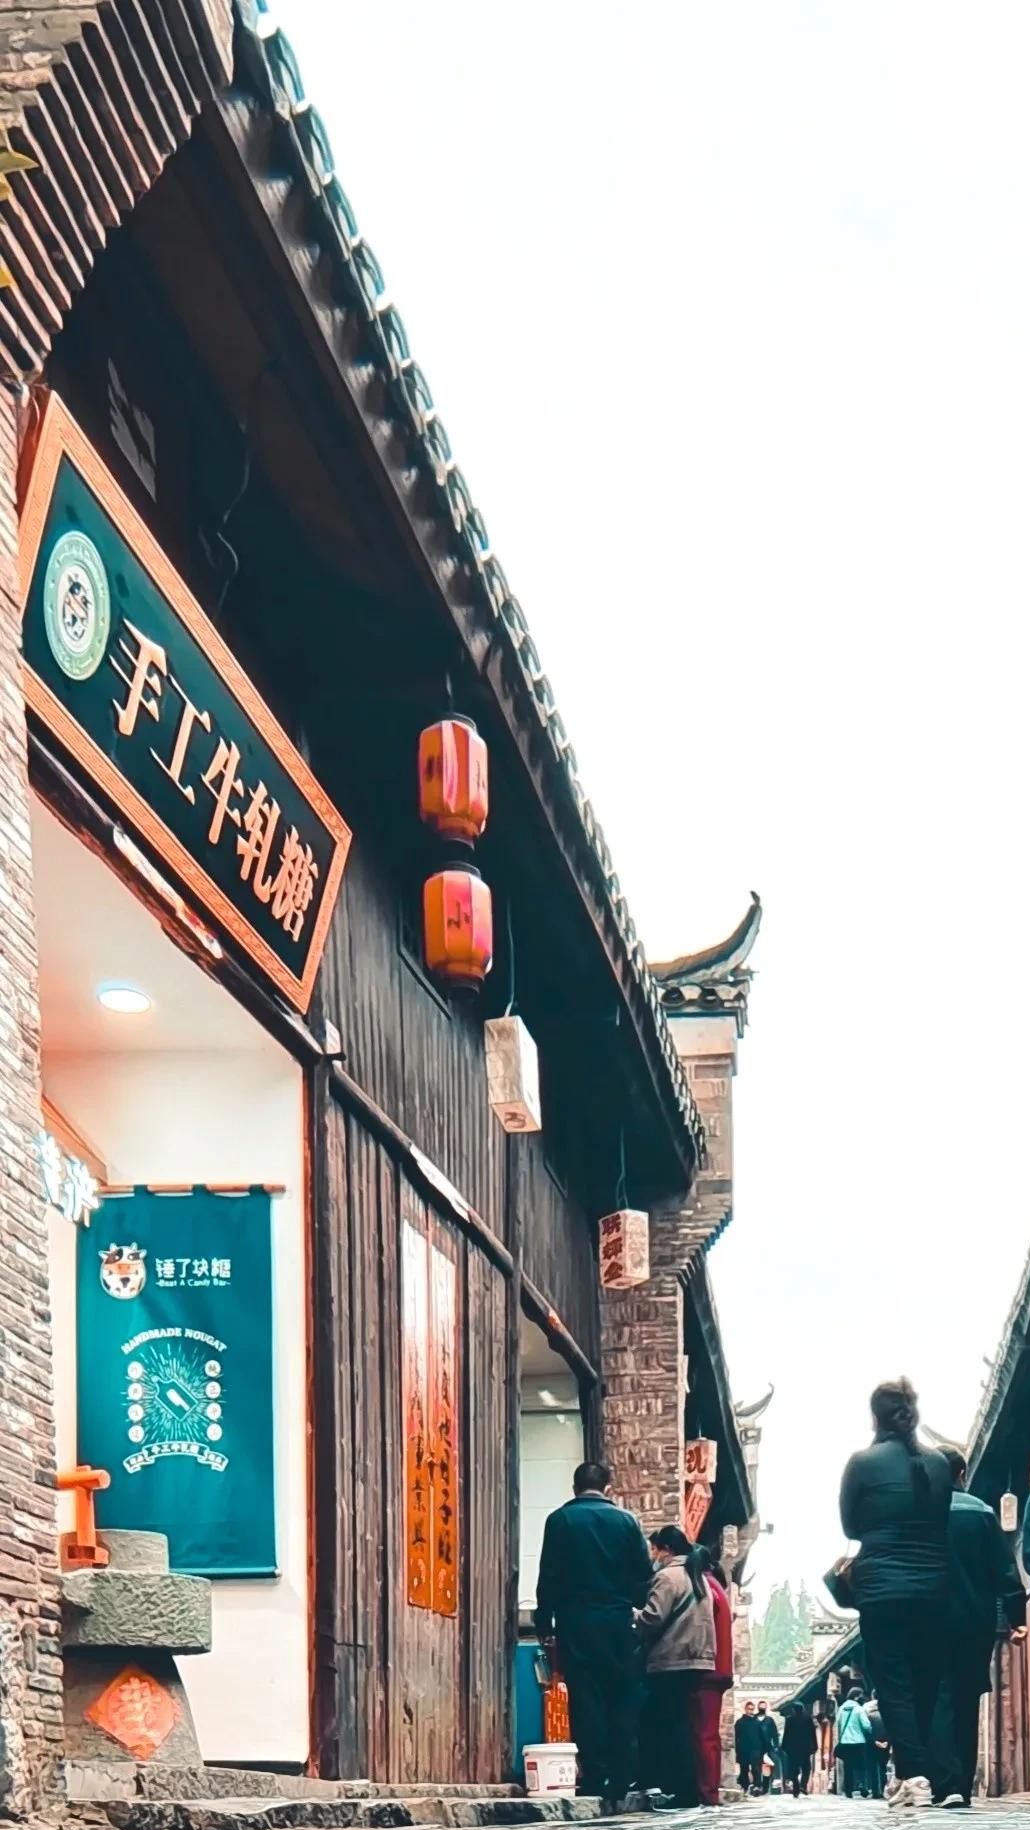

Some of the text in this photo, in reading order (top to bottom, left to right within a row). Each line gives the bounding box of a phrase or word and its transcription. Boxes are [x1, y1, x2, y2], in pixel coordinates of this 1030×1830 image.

[110, 616, 318, 942] 手工牛轧糖
[121, 1327, 228, 1355] HANDMADE NOUGAT
